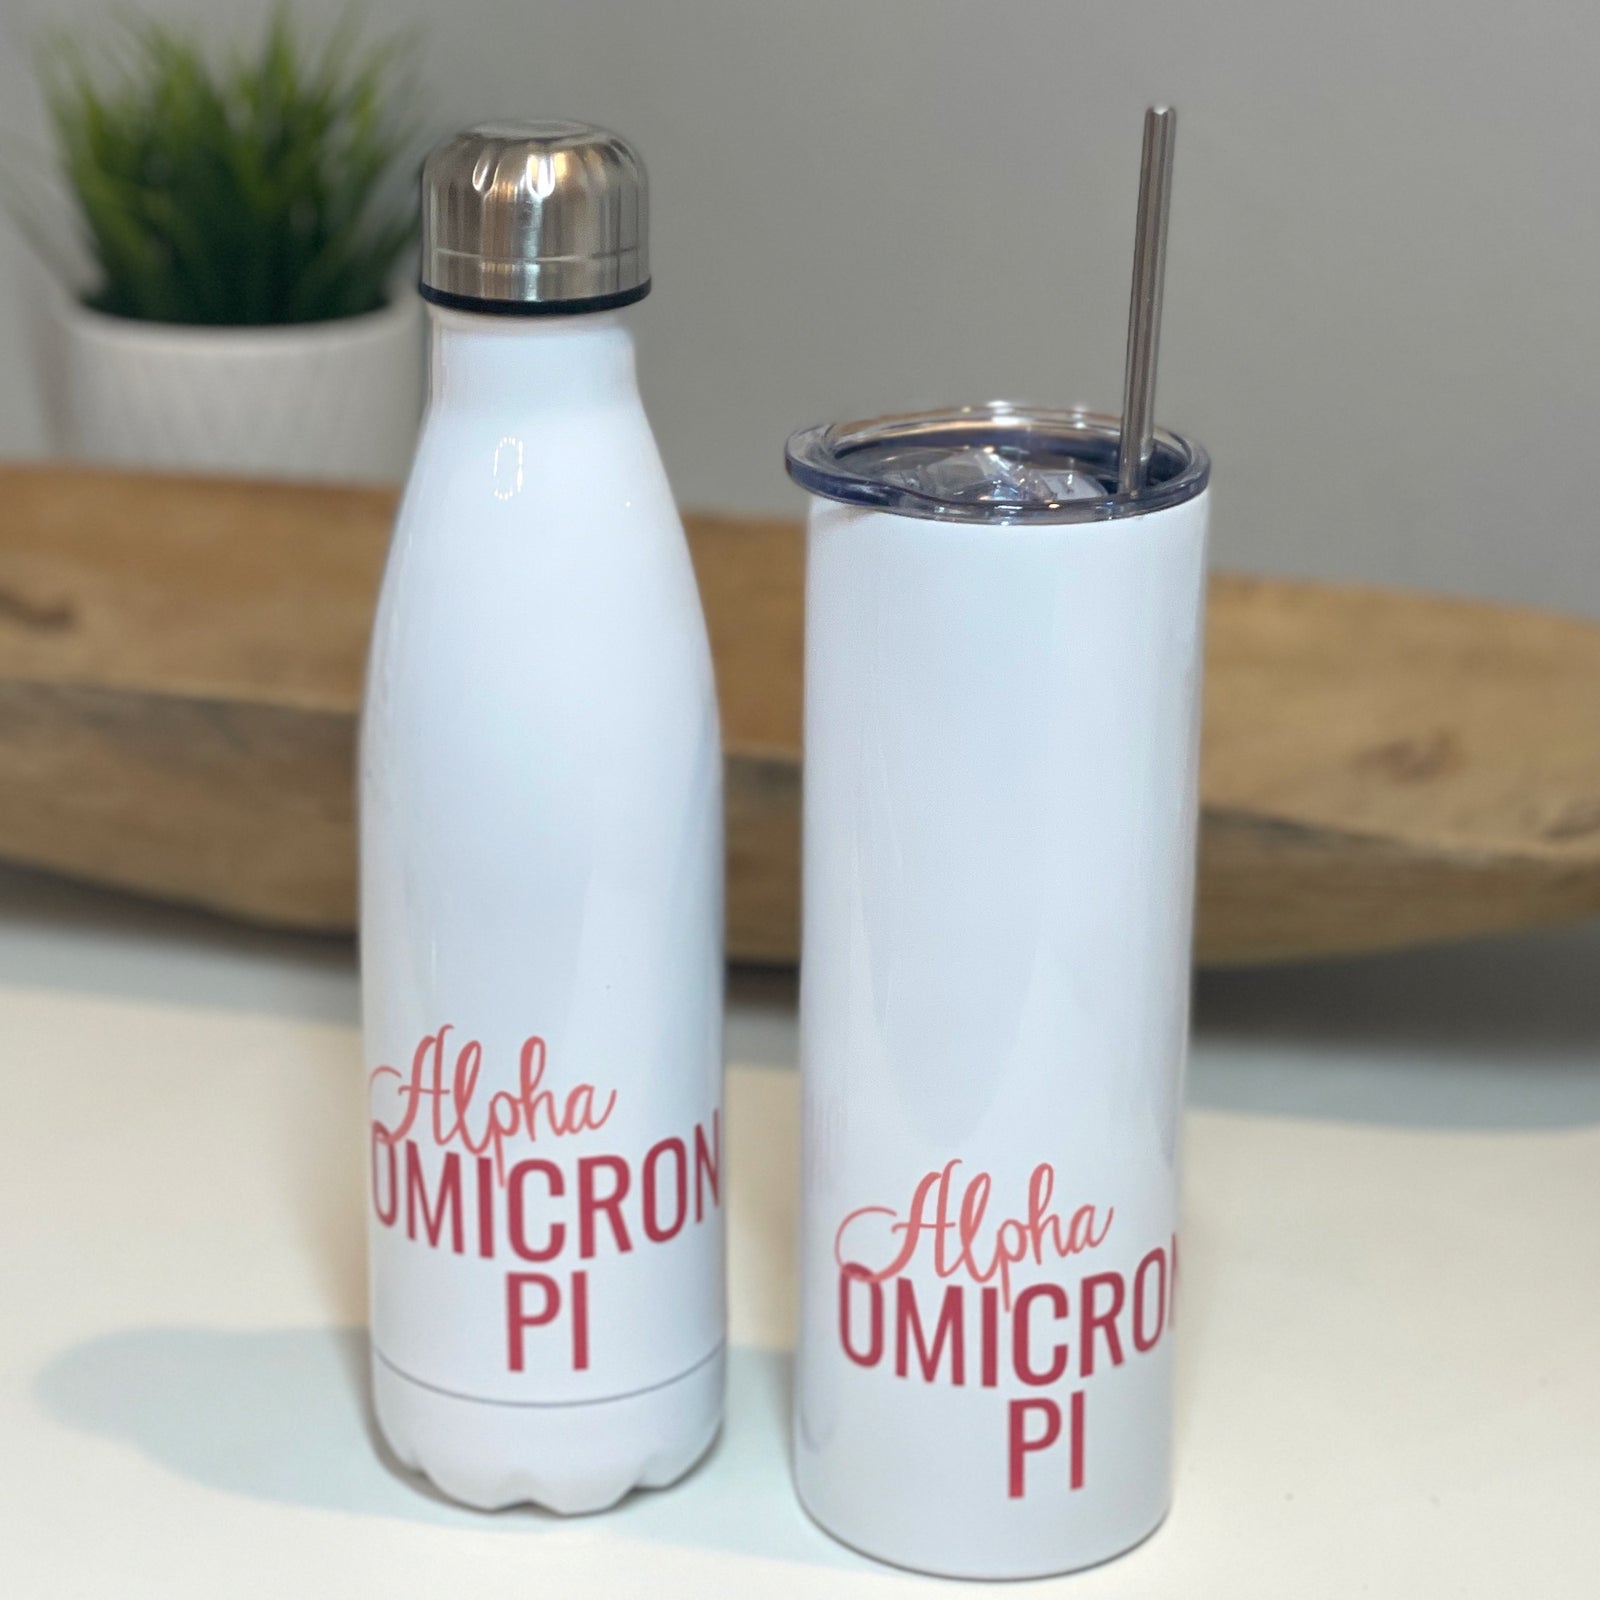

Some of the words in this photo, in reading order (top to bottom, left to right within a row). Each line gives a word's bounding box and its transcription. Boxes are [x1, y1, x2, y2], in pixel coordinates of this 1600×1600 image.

[370, 1024, 617, 1188] Alpha
[372, 1108, 720, 1262] OMICRON
[834, 1158, 1114, 1312] Alpha
[506, 1270, 589, 1372] PI
[1008, 1390, 1085, 1499] PI
